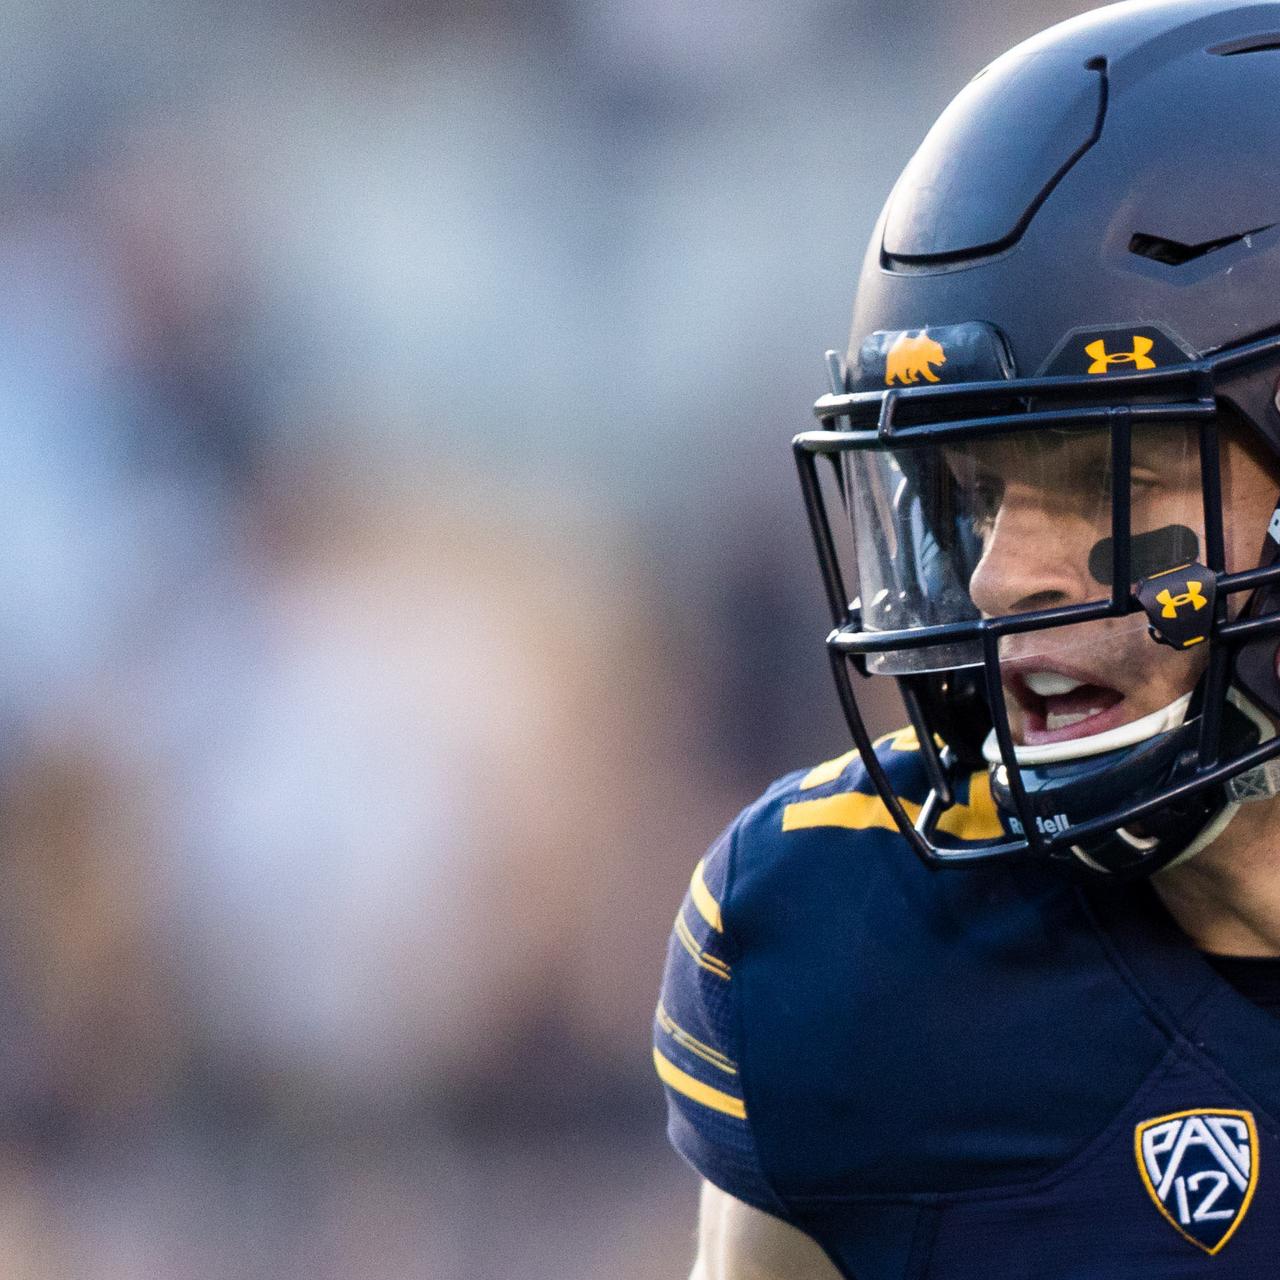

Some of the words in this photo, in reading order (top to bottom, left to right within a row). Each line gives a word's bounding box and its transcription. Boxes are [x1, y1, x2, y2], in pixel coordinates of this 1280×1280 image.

[1008, 813, 1071, 835] Rdell
[1142, 1114, 1250, 1204] PAC
[1175, 1170, 1236, 1225] 12
